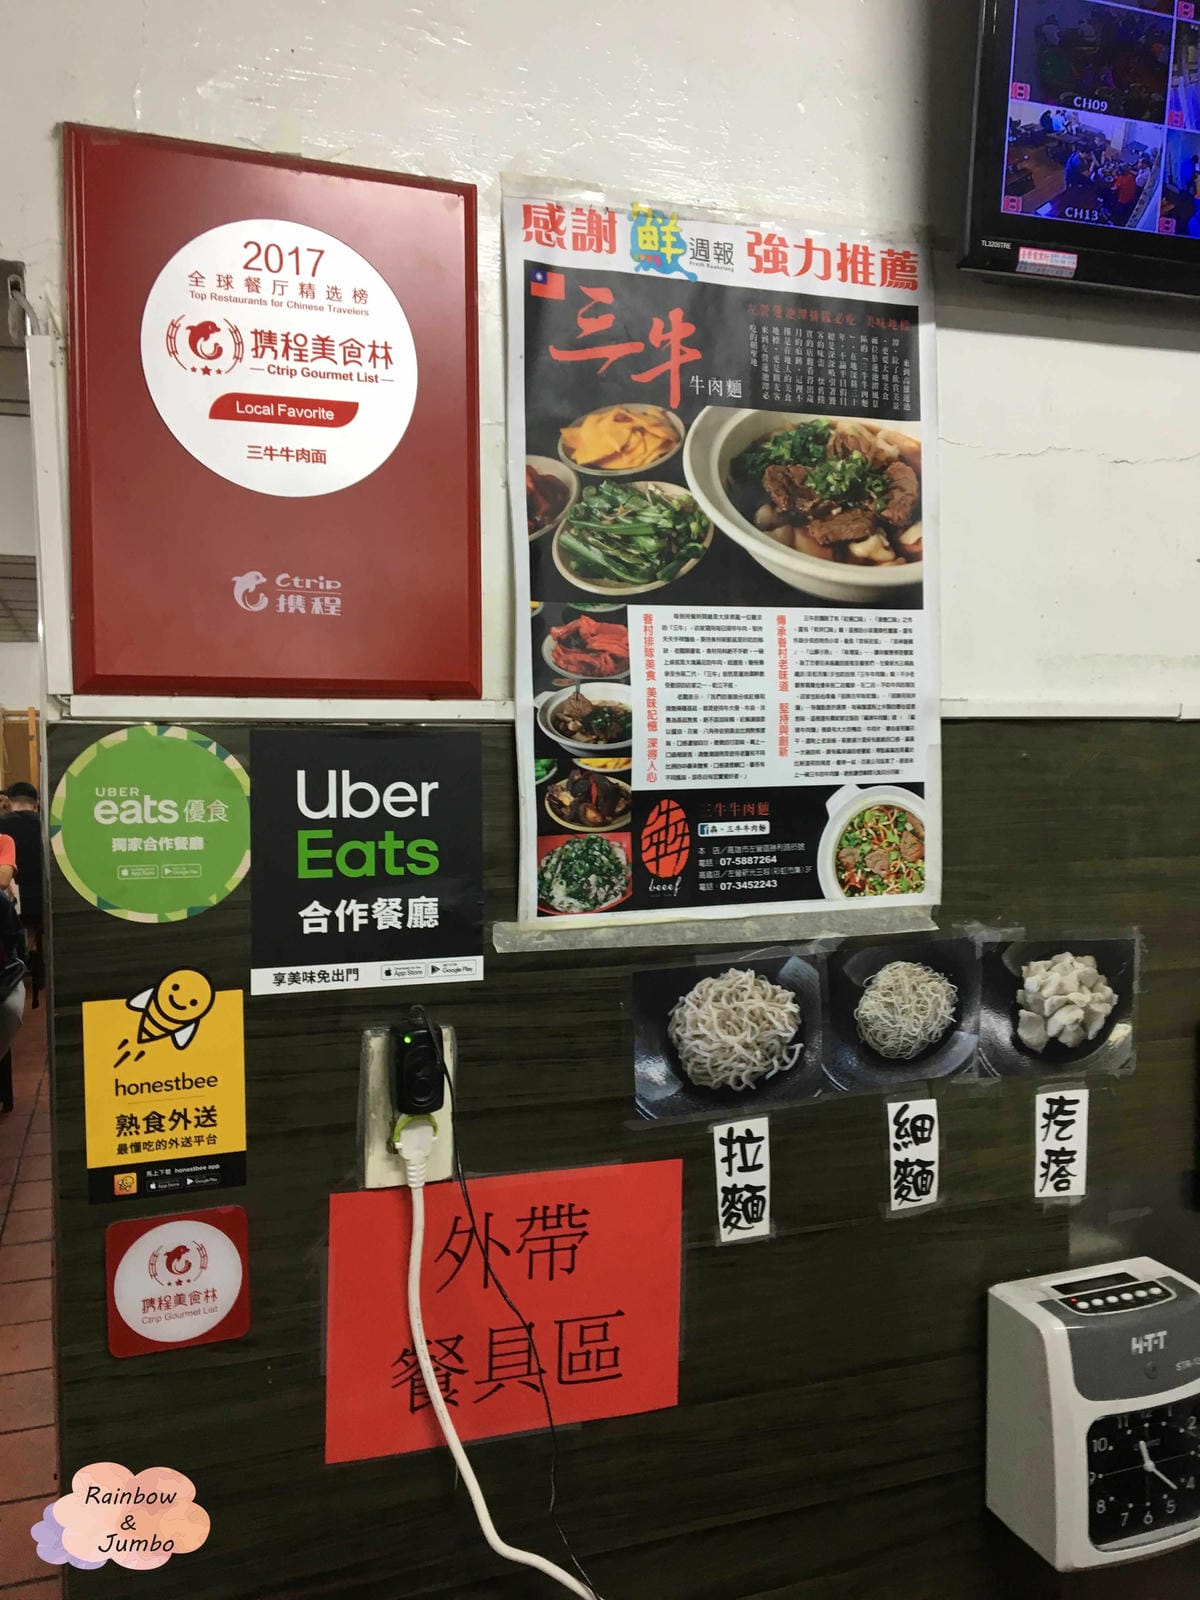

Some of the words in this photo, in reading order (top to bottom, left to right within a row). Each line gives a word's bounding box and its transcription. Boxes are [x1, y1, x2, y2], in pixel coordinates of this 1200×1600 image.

[1073, 96, 1108, 112] CH09
[1065, 206, 1099, 221] CH13
[522, 202, 618, 255] 感謝
[689, 237, 734, 266] 週報
[746, 230, 919, 291] 強力推薦
[243, 241, 325, 277] 2017
[187, 270, 369, 306] 全球餐厅精选榜
[189, 290, 207, 302] Top
[209, 291, 268, 308] Restaurants
[270, 298, 284, 308] for
[286, 300, 325, 312] Chinese
[327, 304, 370, 317] Travelers
[250, 328, 394, 370] 携程美食林
[549, 285, 702, 409] 三牛
[267, 365, 298, 380] Ctrip
[300, 367, 354, 382] Gourmet
[357, 370, 380, 384] List
[688, 375, 742, 399] 牛肉麵
[236, 400, 275, 418] Local
[277, 403, 335, 422] Favorite
[247, 445, 327, 465] 三牛牛肉面
[275, 573, 342, 590] Ctrip
[275, 593, 342, 616] 携程
[647, 738, 658, 783] 深得人心
[95, 786, 139, 797] UBER
[296, 769, 439, 820] Uber
[94, 795, 180, 826] eats
[183, 799, 230, 824] 優食
[702, 802, 770, 817] 三牛牛肉麵
[112, 836, 204, 853] 獨家合作餐廳
[297, 829, 440, 879] Eats
[720, 855, 778, 866] 07-5887264
[720, 880, 778, 891] 07-3452243
[297, 897, 440, 934] 合作餐廳
[272, 968, 360, 986] 享美味免出門
[114, 1072, 218, 1097] honestbee
[115, 1105, 218, 1138] 熟食外送
[116, 1133, 218, 1155] 最懂吃的外送平台
[893, 1103, 936, 1205] 細麵
[174, 1164, 207, 1174] honestbee
[719, 1126, 767, 1235] 拉麵
[434, 1203, 591, 1294] 外帶
[141, 1288, 218, 1315] 携程美食林
[141, 1314, 162, 1325] Ctrip
[164, 1309, 201, 1323] Gourmet
[203, 1306, 218, 1316] List
[390, 1309, 625, 1414] 餐具區
[1187, 1415, 1197, 1430] 2
[1092, 1437, 1108, 1453] 10
[1186, 1476, 1195, 1489] 4
[1096, 1499, 1106, 1514] 8
[1166, 1500, 1176, 1514] 5
[1121, 1512, 1129, 1527] 7
[1143, 1511, 1153, 1525] 6
